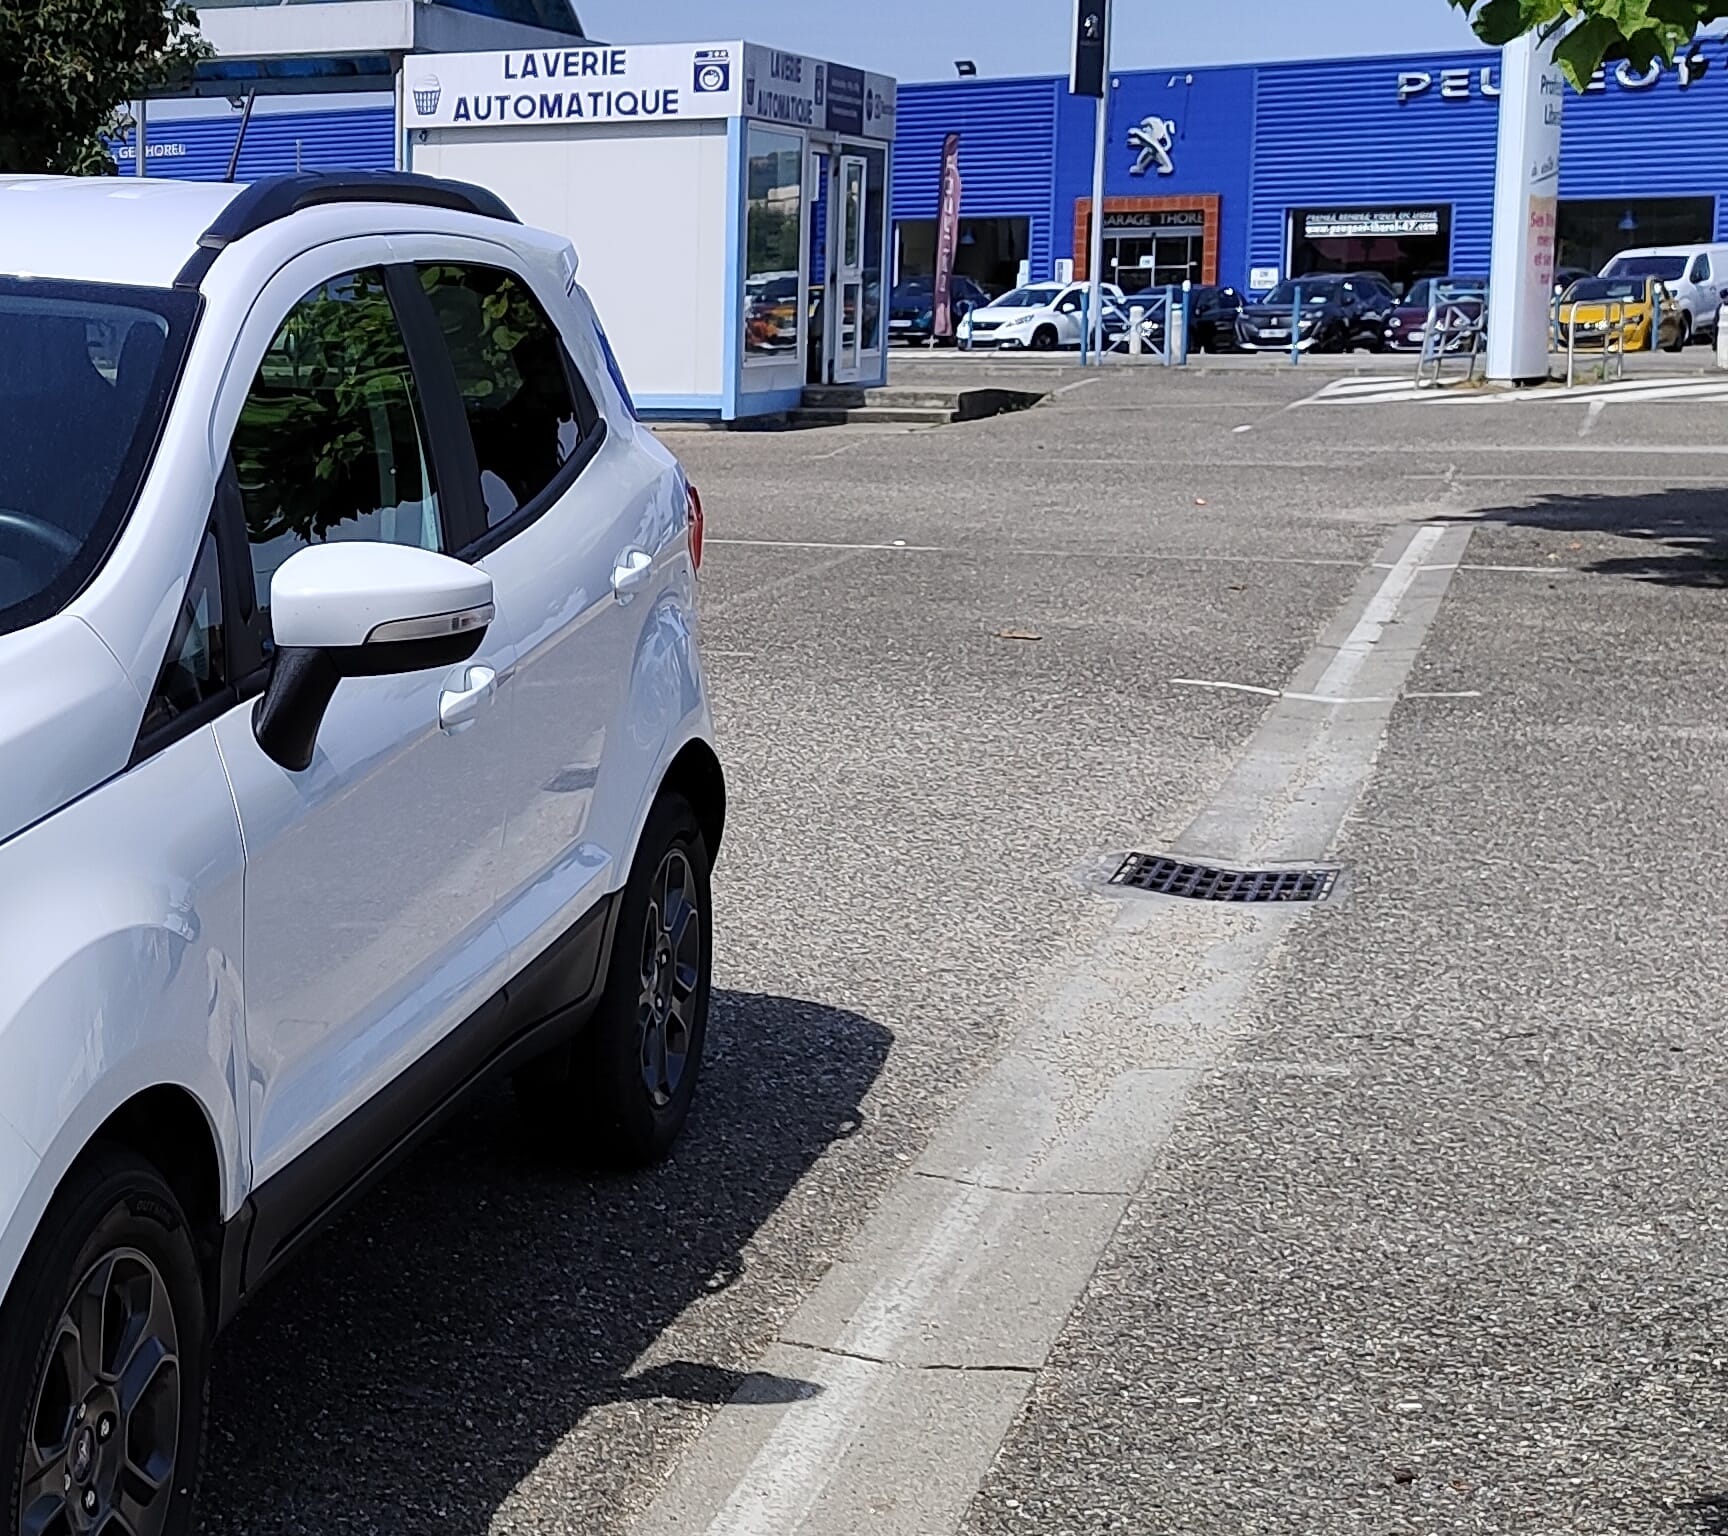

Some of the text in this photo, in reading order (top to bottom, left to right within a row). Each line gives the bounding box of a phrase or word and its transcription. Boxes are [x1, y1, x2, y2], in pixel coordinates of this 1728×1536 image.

[503, 49, 627, 80] LAVERIE
[452, 88, 680, 122] AUTOMATIQUE
[757, 89, 814, 125] AUTOMATIQUE
[1159, 211, 1204, 225] THORE
